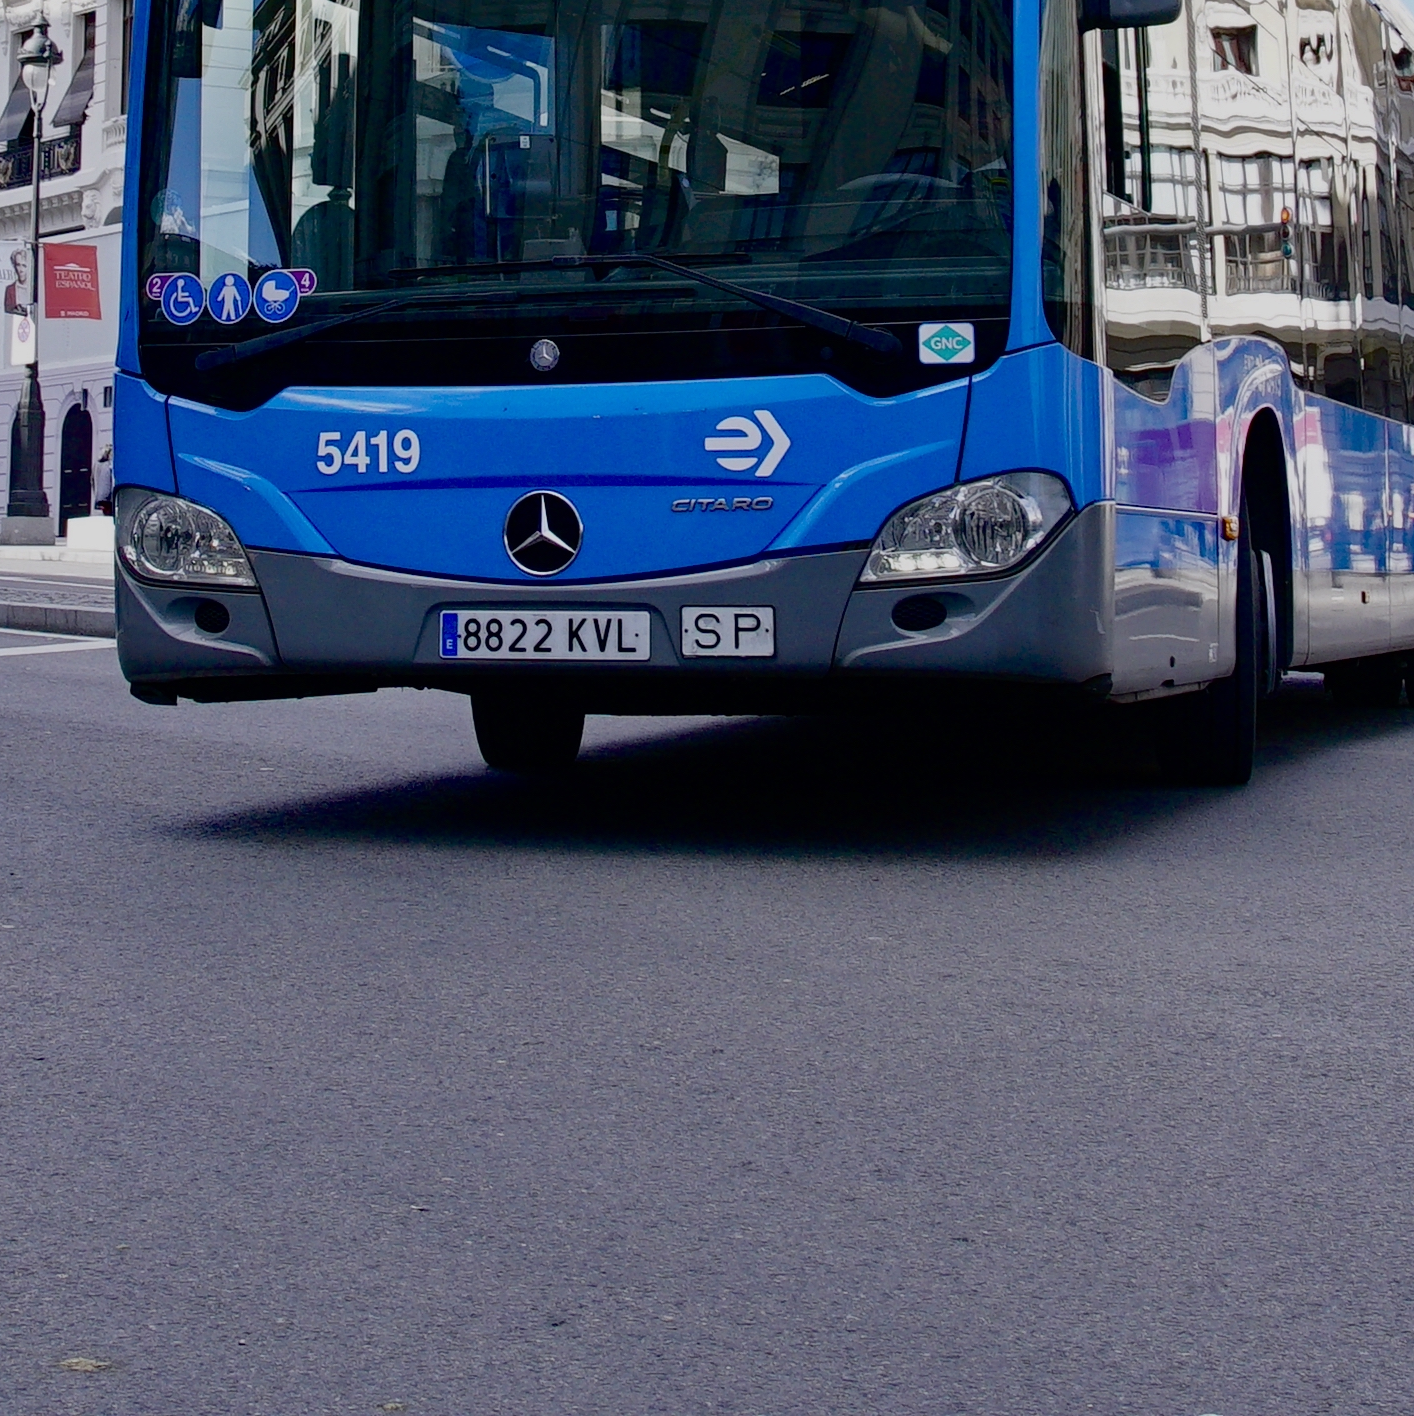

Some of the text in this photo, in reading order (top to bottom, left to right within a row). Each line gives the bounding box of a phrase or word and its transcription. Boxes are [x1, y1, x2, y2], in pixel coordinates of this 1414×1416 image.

[53, 270, 92, 282] TEATRO
[301, 273, 310, 287] 4
[55, 280, 96, 291] ESPAÑOL
[153, 278, 161, 292] 2
[930, 336, 964, 351] GNC
[316, 429, 420, 475] 5419
[671, 496, 774, 512] CITARO
[463, 617, 553, 652] 8822
[567, 617, 637, 653] KVL
